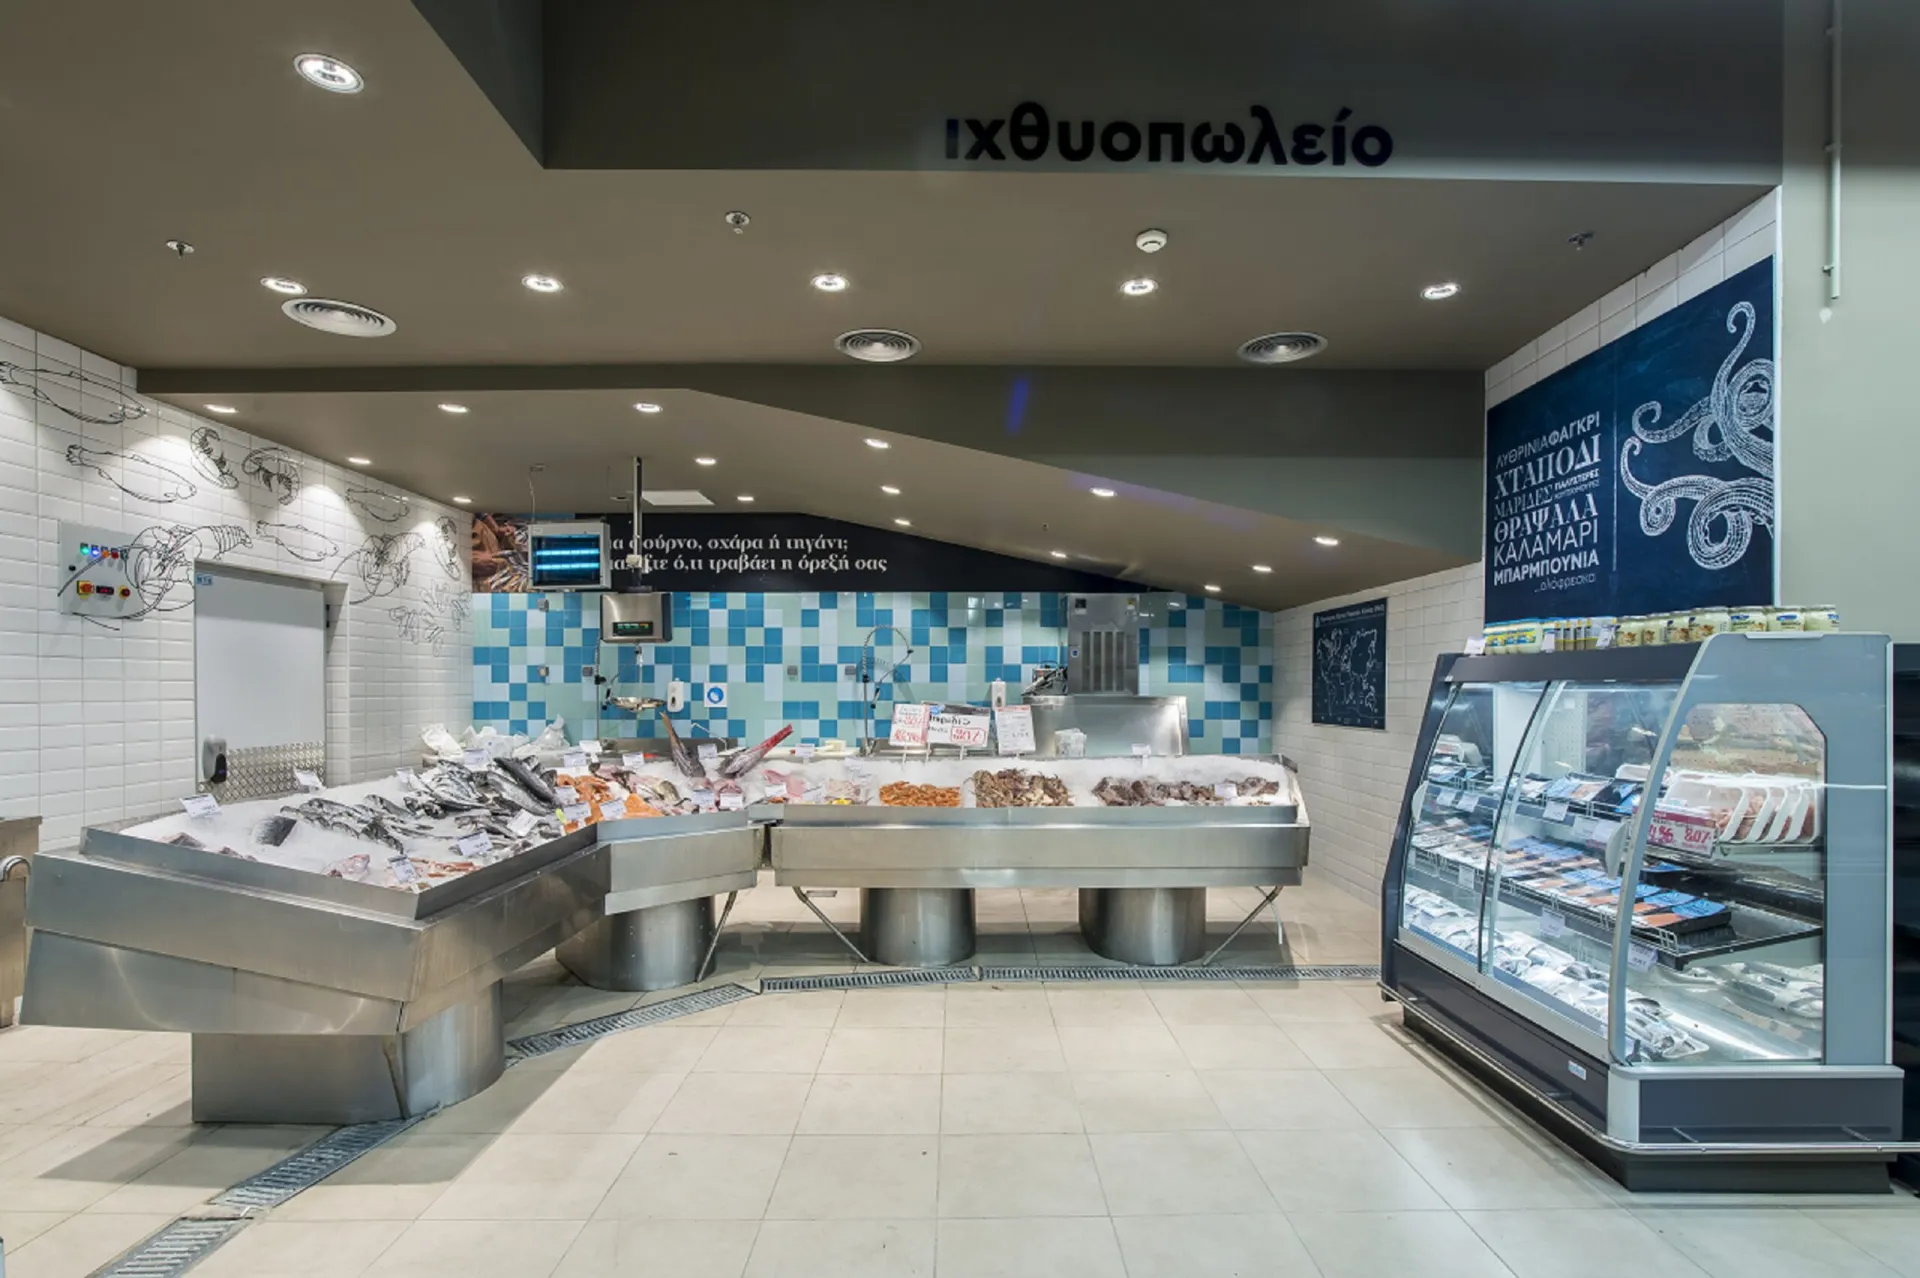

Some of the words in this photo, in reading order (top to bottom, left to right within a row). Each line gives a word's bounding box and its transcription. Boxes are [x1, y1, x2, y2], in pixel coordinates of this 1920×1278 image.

[945, 101, 1394, 167] ιχθυοπωλείο
[1494, 433, 1602, 499] ΧΤΑΠΟΔΙ
[1494, 493, 1599, 543] ΘΡΑΨΑΛΑ
[1494, 518, 1598, 567] ΚΑΛΑΜΑΡΙ
[707, 534, 764, 553] σχάρα
[768, 534, 781, 549] ή
[710, 553, 776, 574] τραβάει
[781, 559, 793, 570] η
[798, 553, 850, 574] όρεξή
[854, 558, 888, 573] σας
[1493, 549, 1600, 586] ΜΠΑΡΜΠΟΥΝΙΑ
